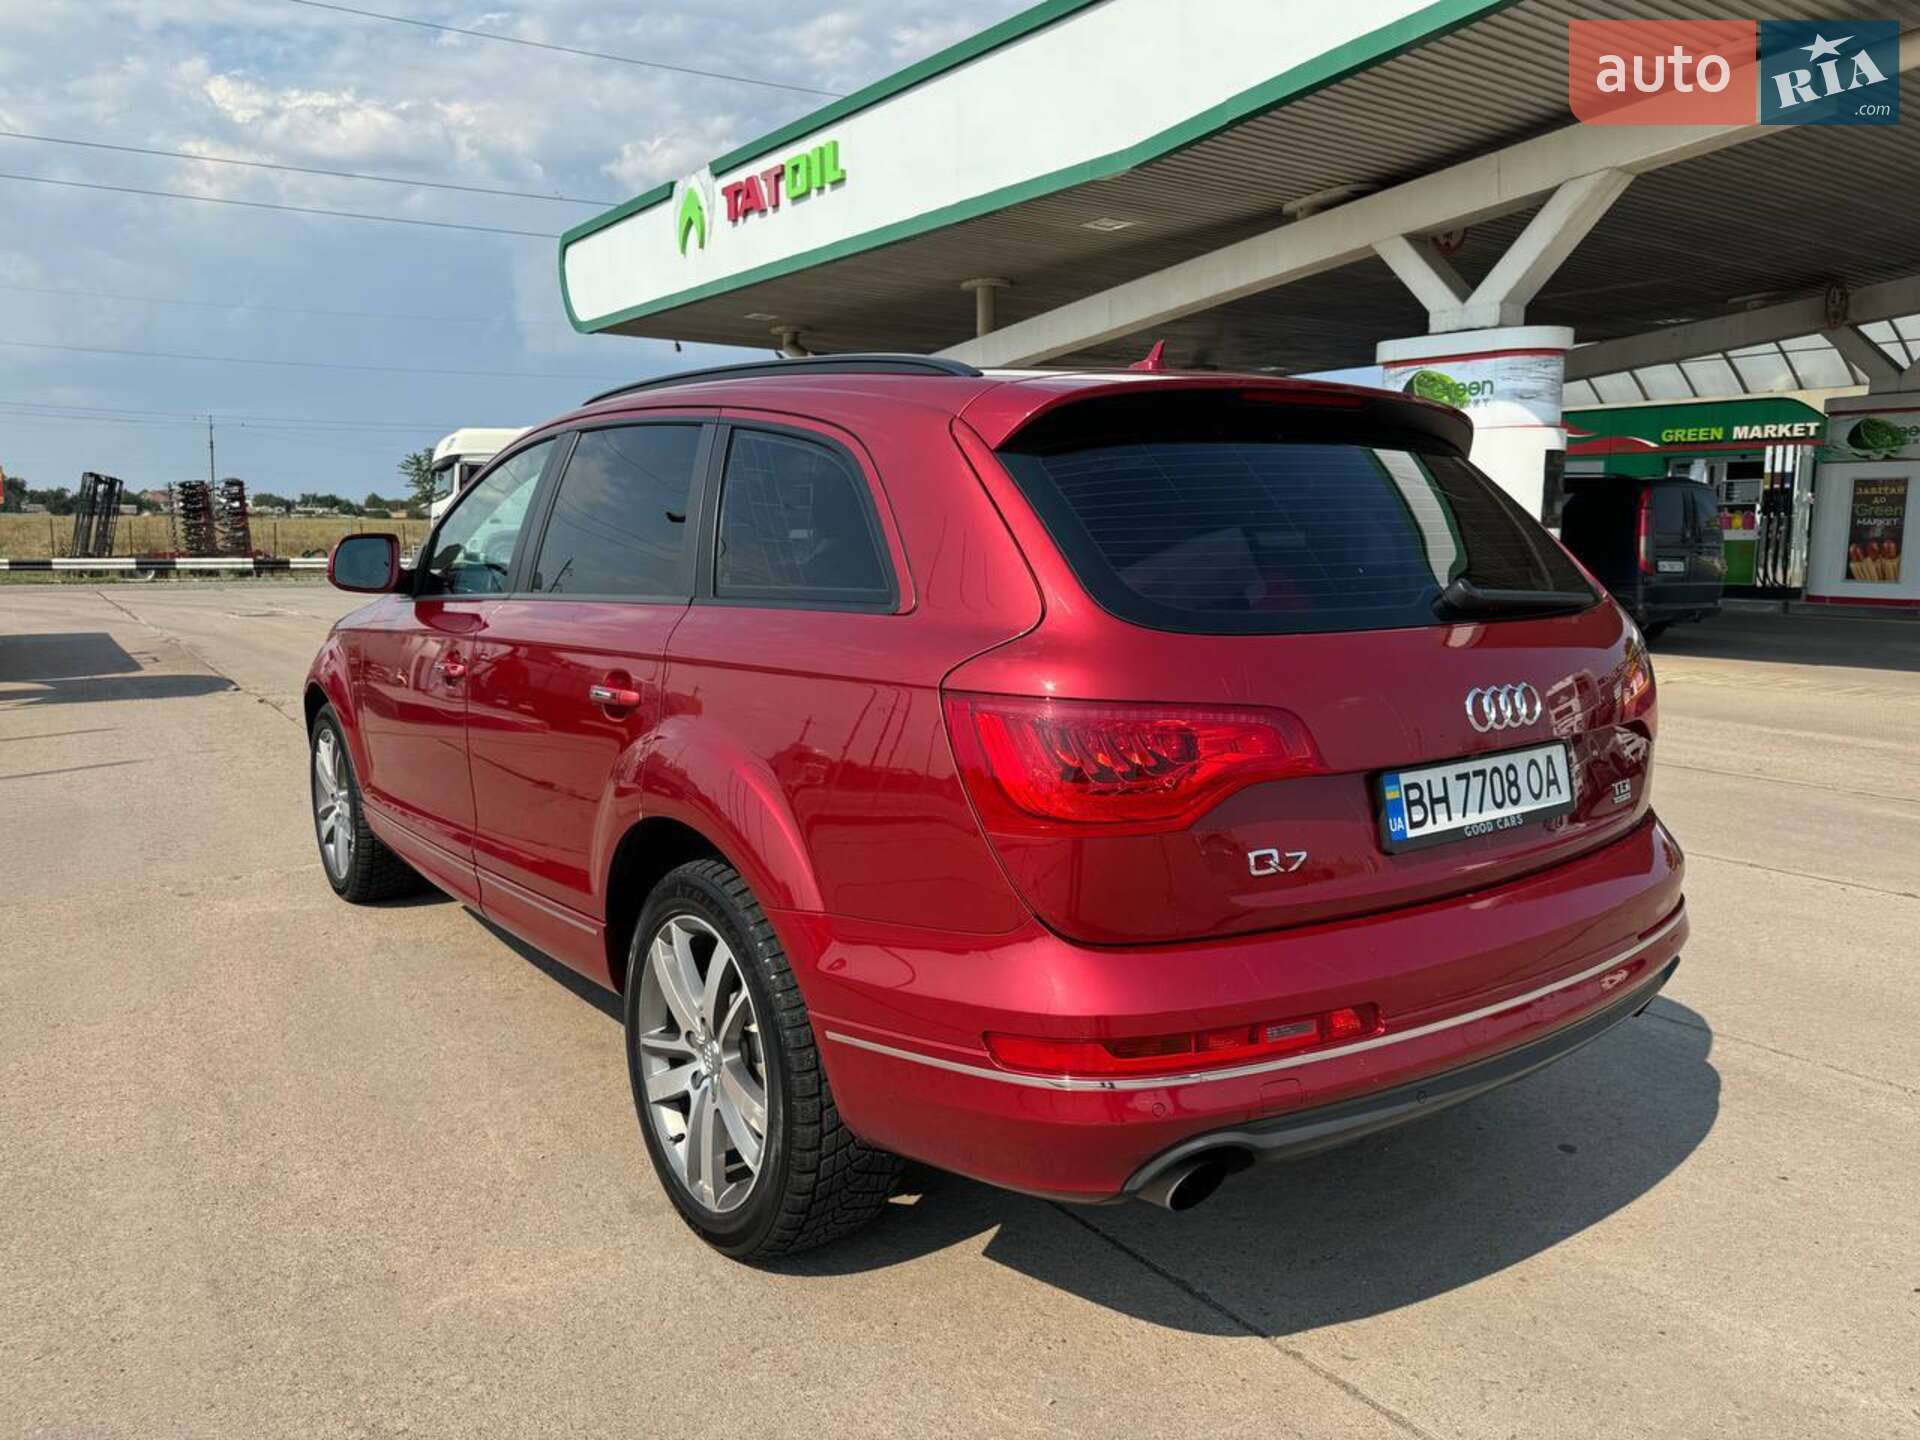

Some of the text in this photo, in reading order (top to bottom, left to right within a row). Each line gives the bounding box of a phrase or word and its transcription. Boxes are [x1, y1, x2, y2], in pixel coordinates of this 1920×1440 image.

[721, 140, 847, 224] TATOIL
[1661, 421, 1821, 443] GREEN MARKET
[1403, 754, 1562, 830] BH 7708 OA
[1389, 816, 1405, 832] UA
[1463, 814, 1524, 837] GOOD CARS
[1248, 848, 1307, 876] Q7
